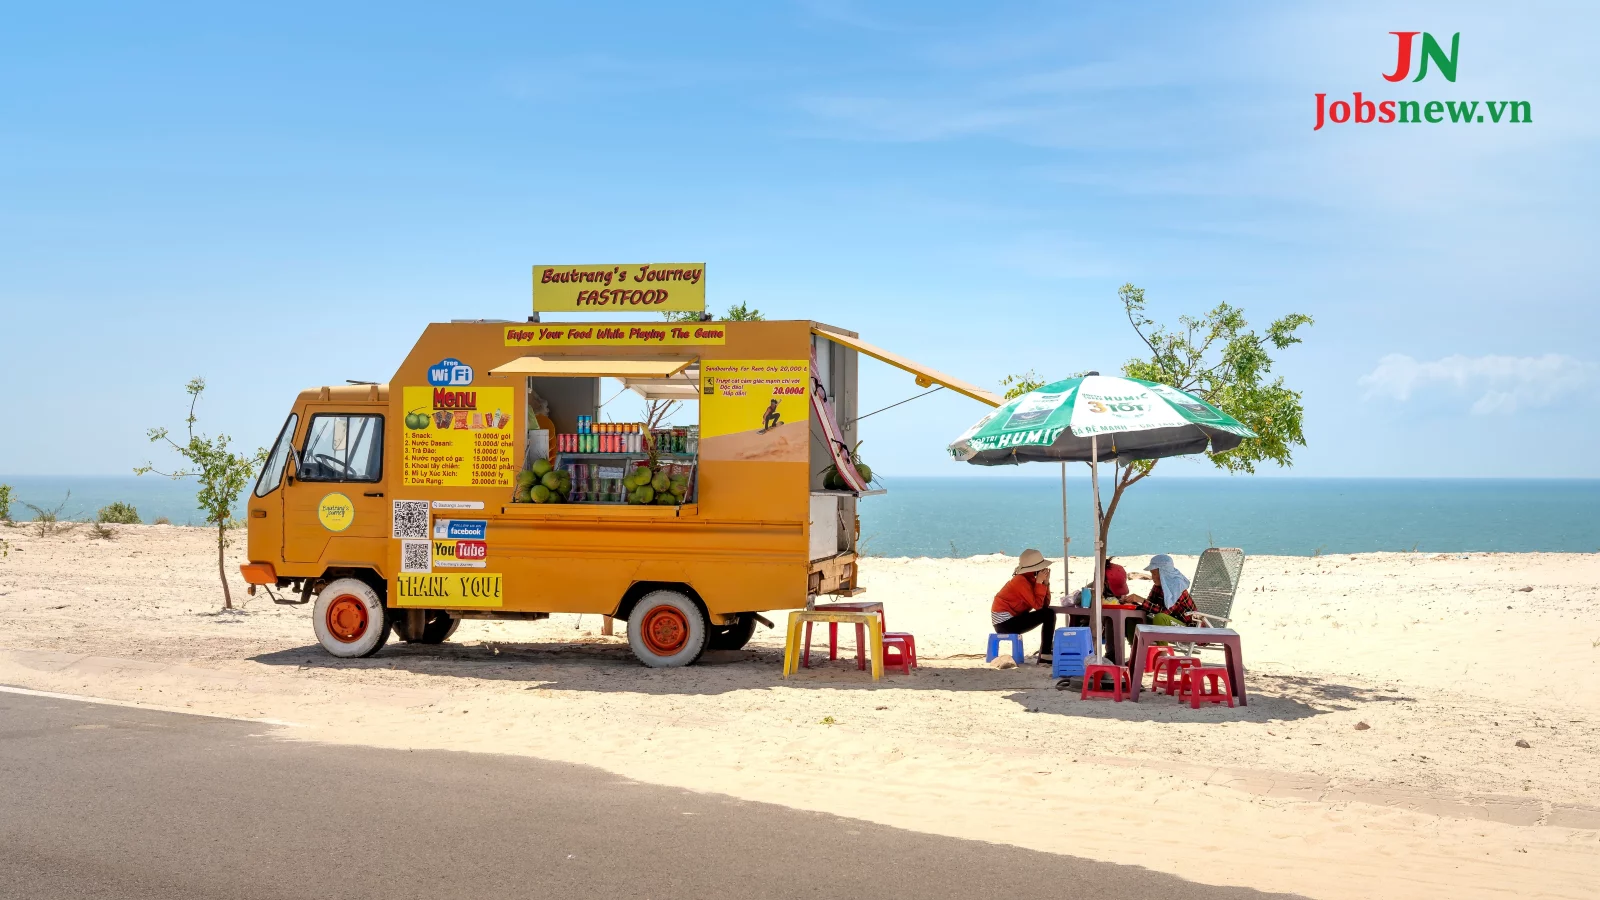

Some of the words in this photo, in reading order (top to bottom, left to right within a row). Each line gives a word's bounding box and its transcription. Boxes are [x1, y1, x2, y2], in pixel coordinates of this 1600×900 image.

[541, 266, 627, 286] Bautrang's
[634, 265, 702, 284] Journey
[577, 288, 669, 306] FASTFOOD
[507, 329, 534, 341] Enjoy
[539, 328, 564, 339] Your
[567, 328, 593, 339] Food
[596, 328, 625, 339] While
[629, 328, 666, 341] Playing
[671, 328, 690, 339] The
[694, 328, 724, 339] Game
[433, 387, 477, 408] Menu
[773, 387, 805, 395] 20.000đ
[1103, 392, 1149, 401] HUMIC
[1088, 401, 1107, 413] 3
[450, 527, 481, 535] facebook
[435, 542, 485, 557] YouTube
[398, 576, 451, 597] THANK
[460, 576, 502, 597] YOU!
